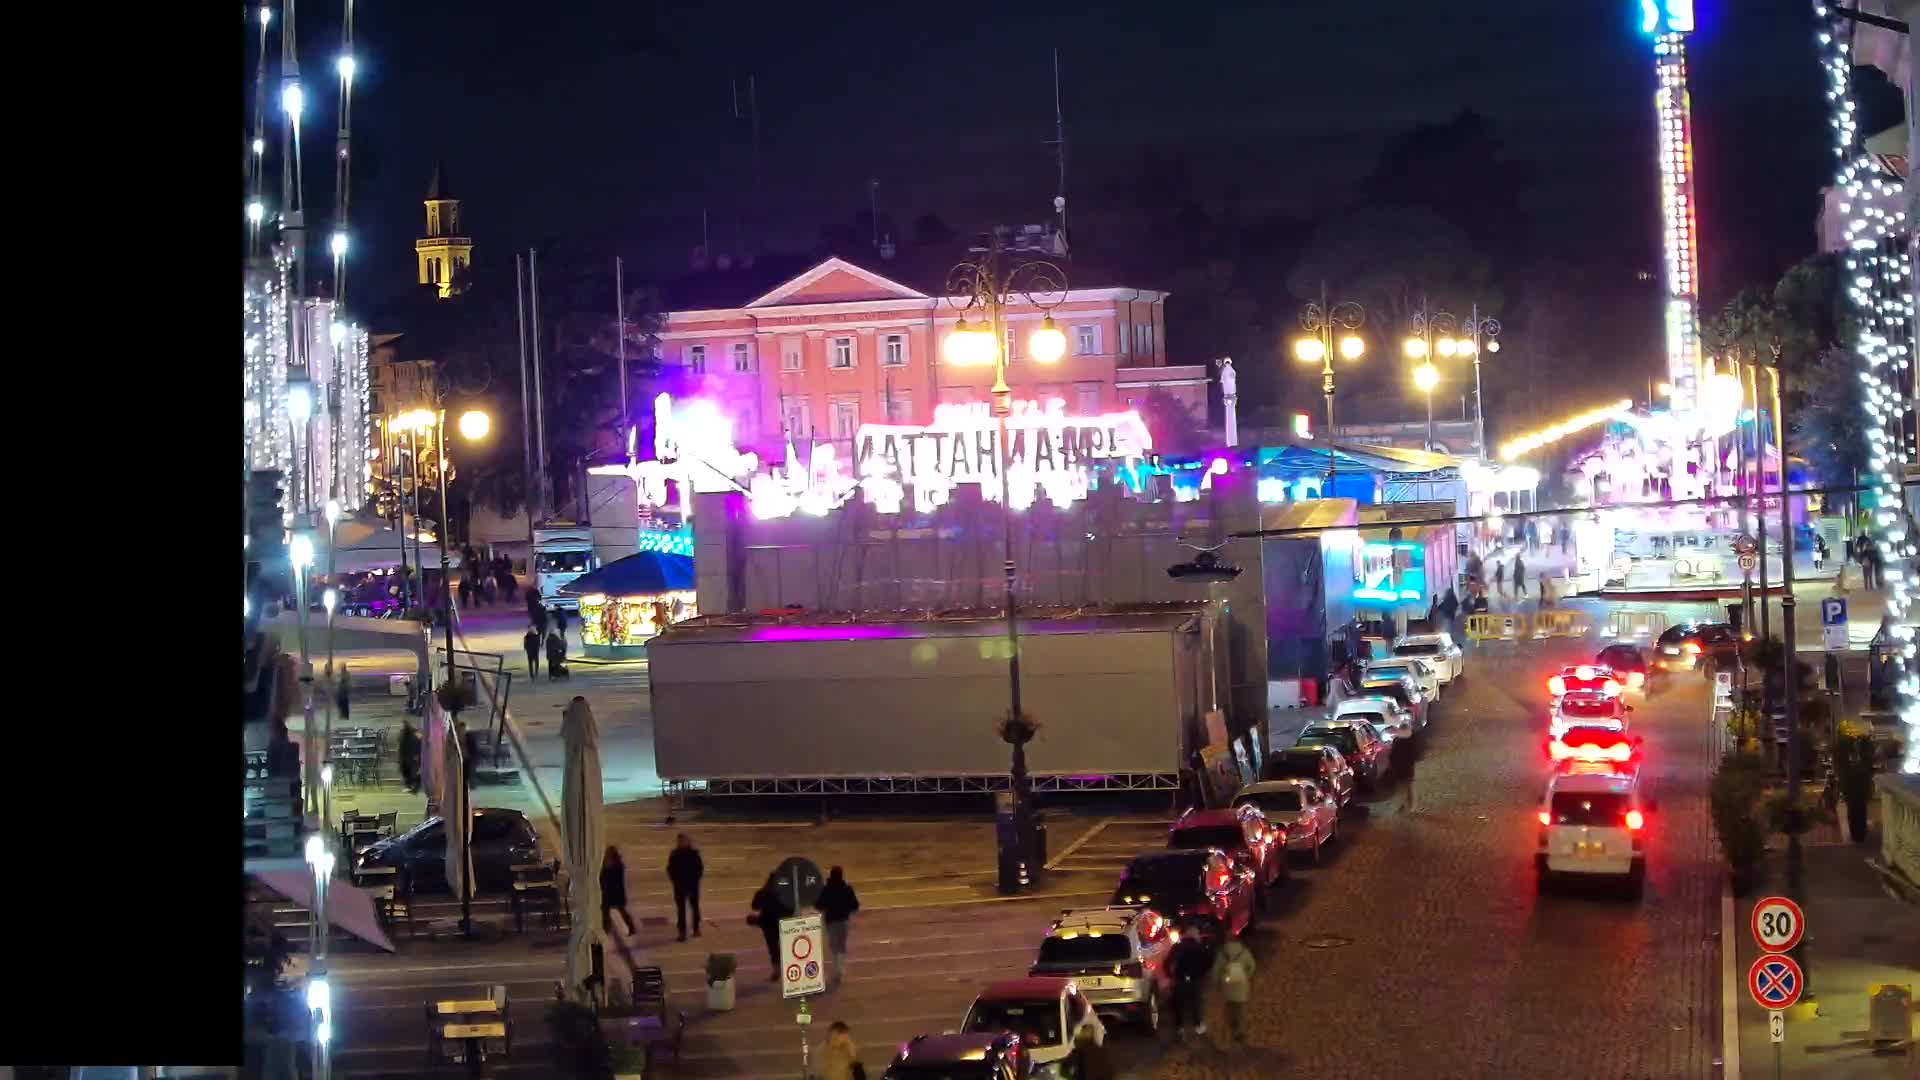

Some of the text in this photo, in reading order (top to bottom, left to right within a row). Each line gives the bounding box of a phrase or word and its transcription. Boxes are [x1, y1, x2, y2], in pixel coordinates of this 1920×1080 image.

[1742, 557, 1753, 567] 20
[1827, 603, 1842, 621] P
[1762, 912, 1792, 937] 30
